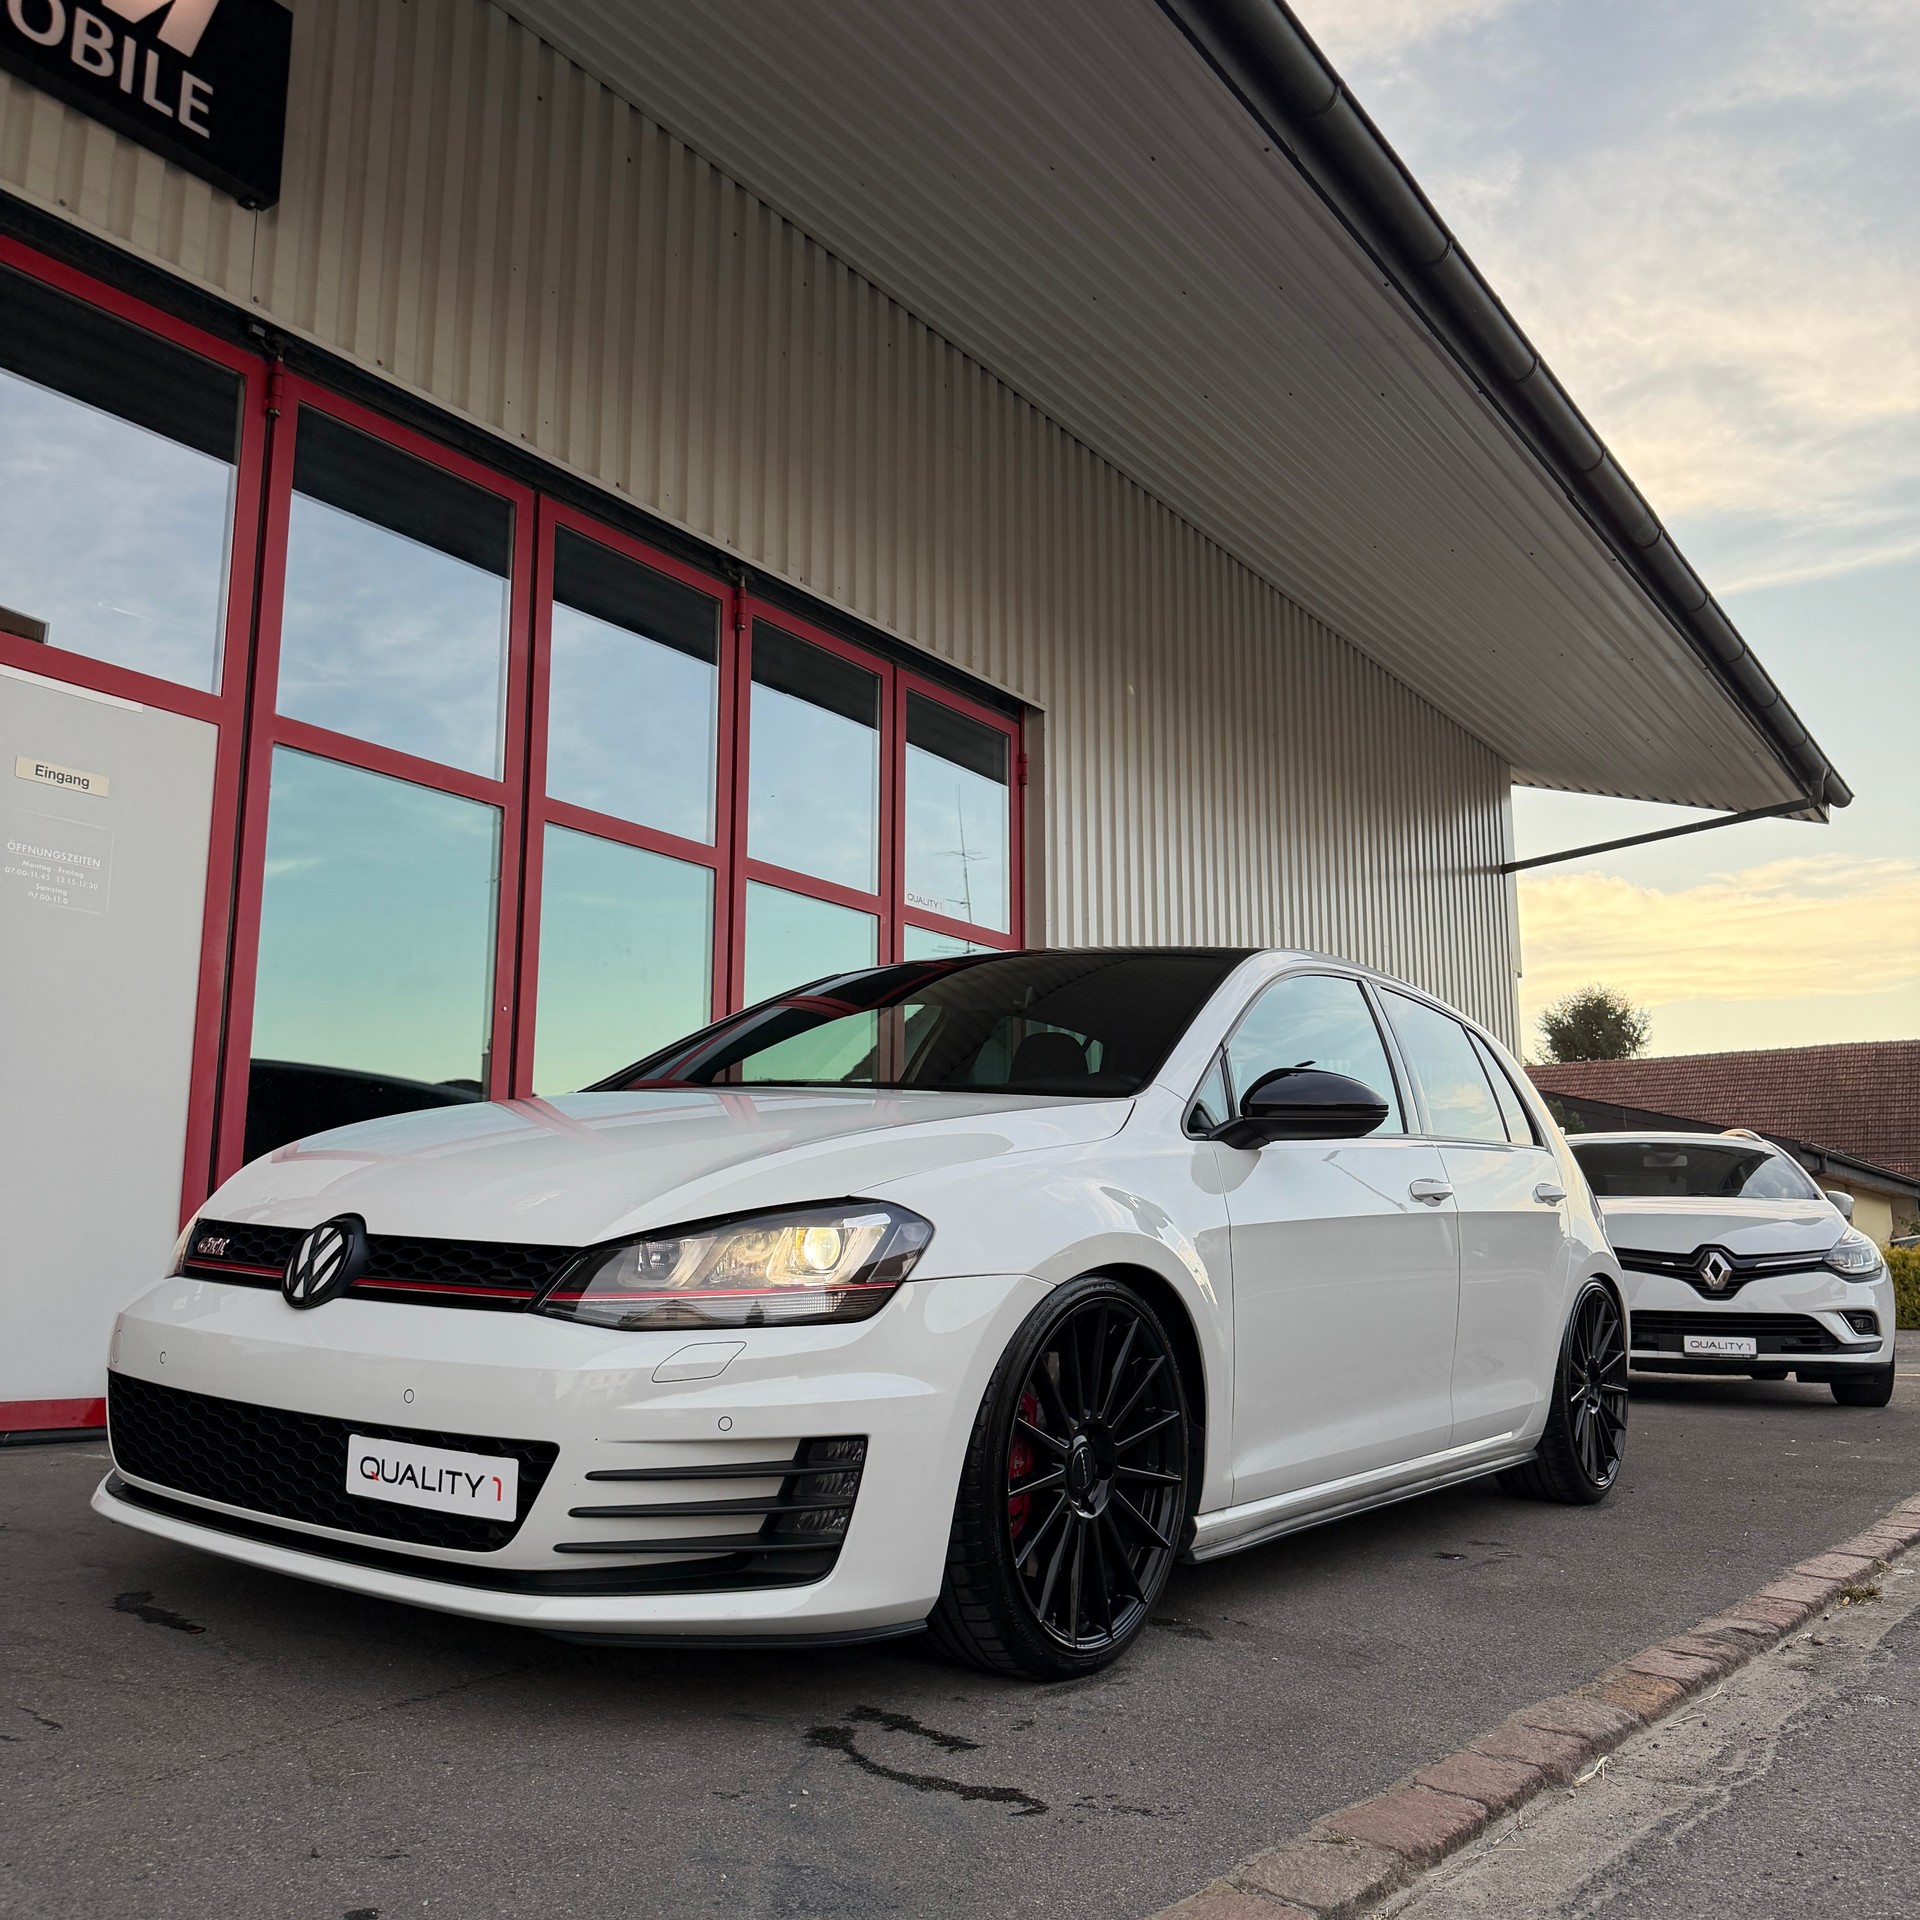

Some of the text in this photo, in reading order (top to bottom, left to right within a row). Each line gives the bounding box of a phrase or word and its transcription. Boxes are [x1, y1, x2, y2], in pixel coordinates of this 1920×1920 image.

[34, 764, 90, 790] Eingang
[7, 839, 101, 868] ÖFFNUNGSZEITEN
[22, 860, 52, 873] Montag
[58, 866, 84, 879] Freitag
[35, 883, 68, 896] Samstag
[197, 1237, 230, 1256] GTI
